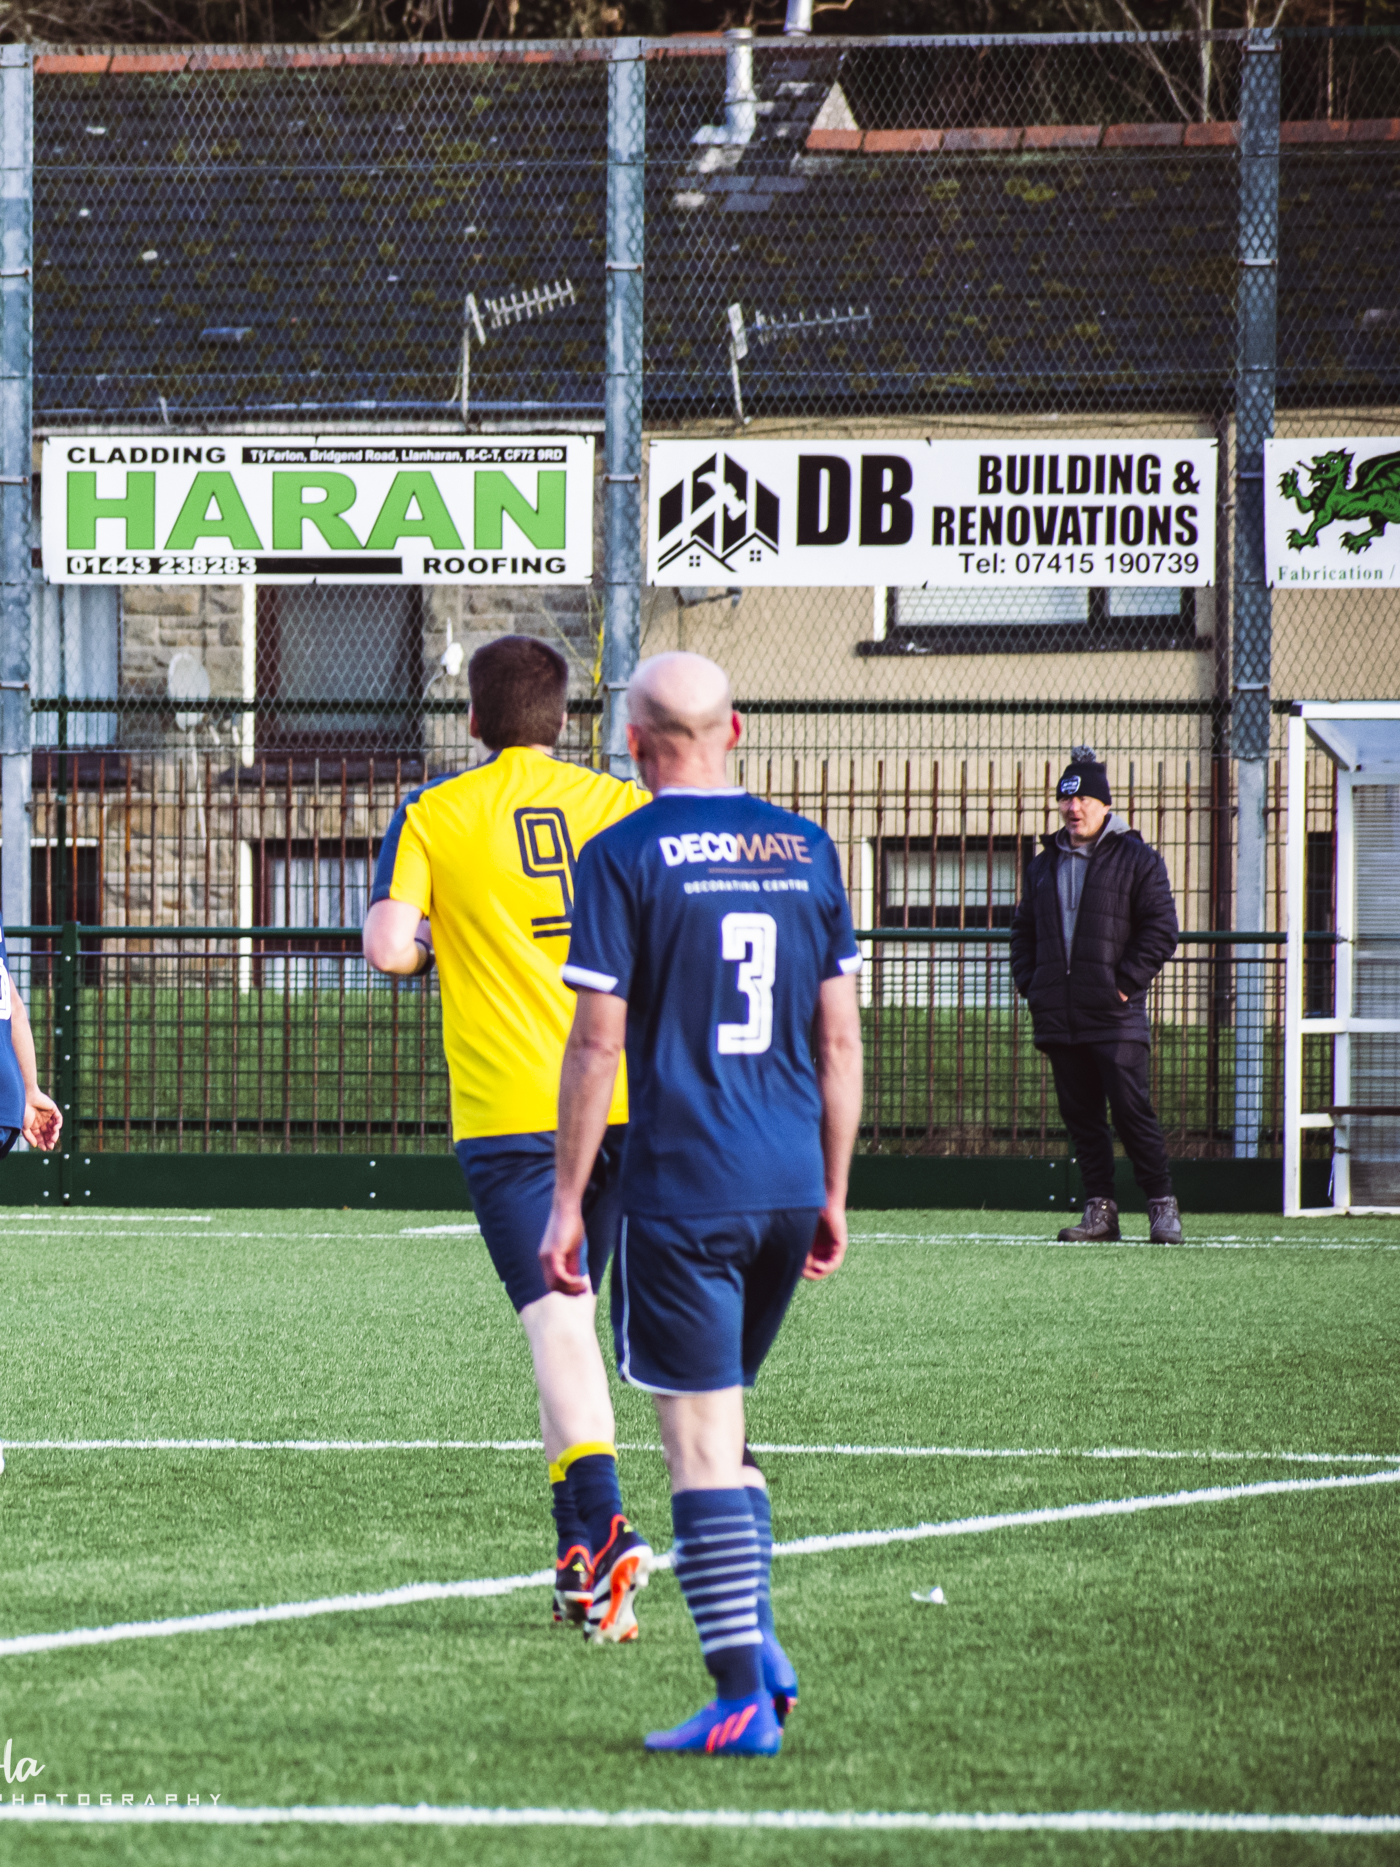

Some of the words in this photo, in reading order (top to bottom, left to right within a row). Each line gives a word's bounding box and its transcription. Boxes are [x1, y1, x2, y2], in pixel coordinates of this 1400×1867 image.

[68, 447, 225, 463] CLADDING
[309, 449, 363, 464] Bridgend
[364, 449, 399, 463] Road,
[401, 449, 463, 463] Llanharan,
[465, 448, 502, 462] R-C-T,
[504, 448, 536, 462] CF72
[537, 448, 564, 462] 9RD
[979, 454, 1161, 495] BUILDING
[1173, 461, 1200, 495] &
[67, 471, 566, 550] HARAN
[797, 455, 913, 546] DB
[932, 505, 1198, 546] RENOVATIONS
[69, 557, 151, 575] 01443
[158, 557, 258, 575] 238283
[424, 557, 565, 574] ROOFING
[959, 553, 1005, 573] Tel:
[1016, 553, 1093, 573] 07415
[1106, 553, 1198, 573] 190739
[1279, 566, 1383, 580] Fabrication
[658, 832, 813, 867] DECOMATE
[513, 807, 578, 939] 9
[683, 879, 760, 895] DECORATING
[762, 879, 809, 892] CENTRE
[717, 912, 777, 1054] 3
